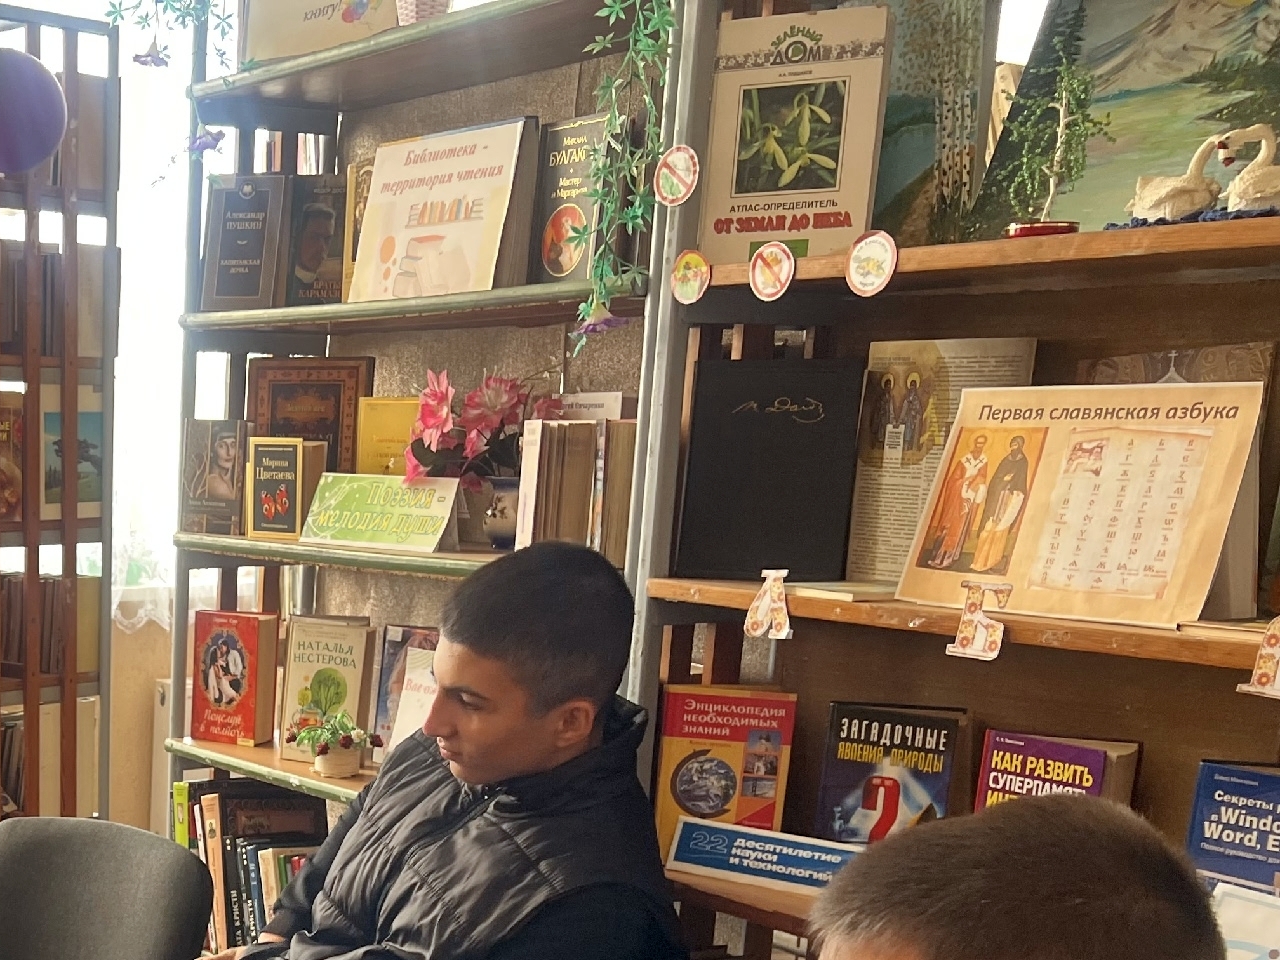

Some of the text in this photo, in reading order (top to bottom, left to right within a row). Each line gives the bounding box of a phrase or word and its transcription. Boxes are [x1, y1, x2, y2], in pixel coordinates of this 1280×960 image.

[771, 40, 821, 65] ДОМ
[404, 142, 476, 167] Библиотека
[549, 146, 594, 167] БУЛГАК
[381, 164, 504, 197] территория чтения
[226, 210, 265, 221] Александр
[729, 199, 838, 213] АТЛАС-ОПРЕДЕЛИТЕЛЬ
[226, 220, 262, 230] ПУШКИН
[714, 217, 734, 235] ОТ
[788, 213, 811, 232] ДО
[978, 401, 1240, 423] Первая славянская азбука
[262, 457, 289, 467] Марина
[256, 467, 295, 481] Цветаева
[366, 481, 437, 509] Поэзия
[316, 508, 446, 543] мелодия души
[297, 640, 354, 656] НАТАЛЬЯ
[293, 654, 357, 669] НЕСТЕРОВА
[682, 725, 730, 736] ЗНАНИЙ
[683, 713, 778, 728] НЕОБХОДИМЫХ
[840, 717, 948, 752] ЗАГАДОЧНЫЕ
[837, 741, 944, 774] ЯВЛЕНИЯ ПРИРОДЫ
[991, 749, 1094, 788] КАК РАЗВИТЬ
[1214, 790, 1274, 810] Секреты
[1204, 821, 1261, 850] Word,
[690, 831, 842, 863] 22 десятилетие
[730, 847, 778, 863] науки
[729, 856, 833, 882] и технологий
